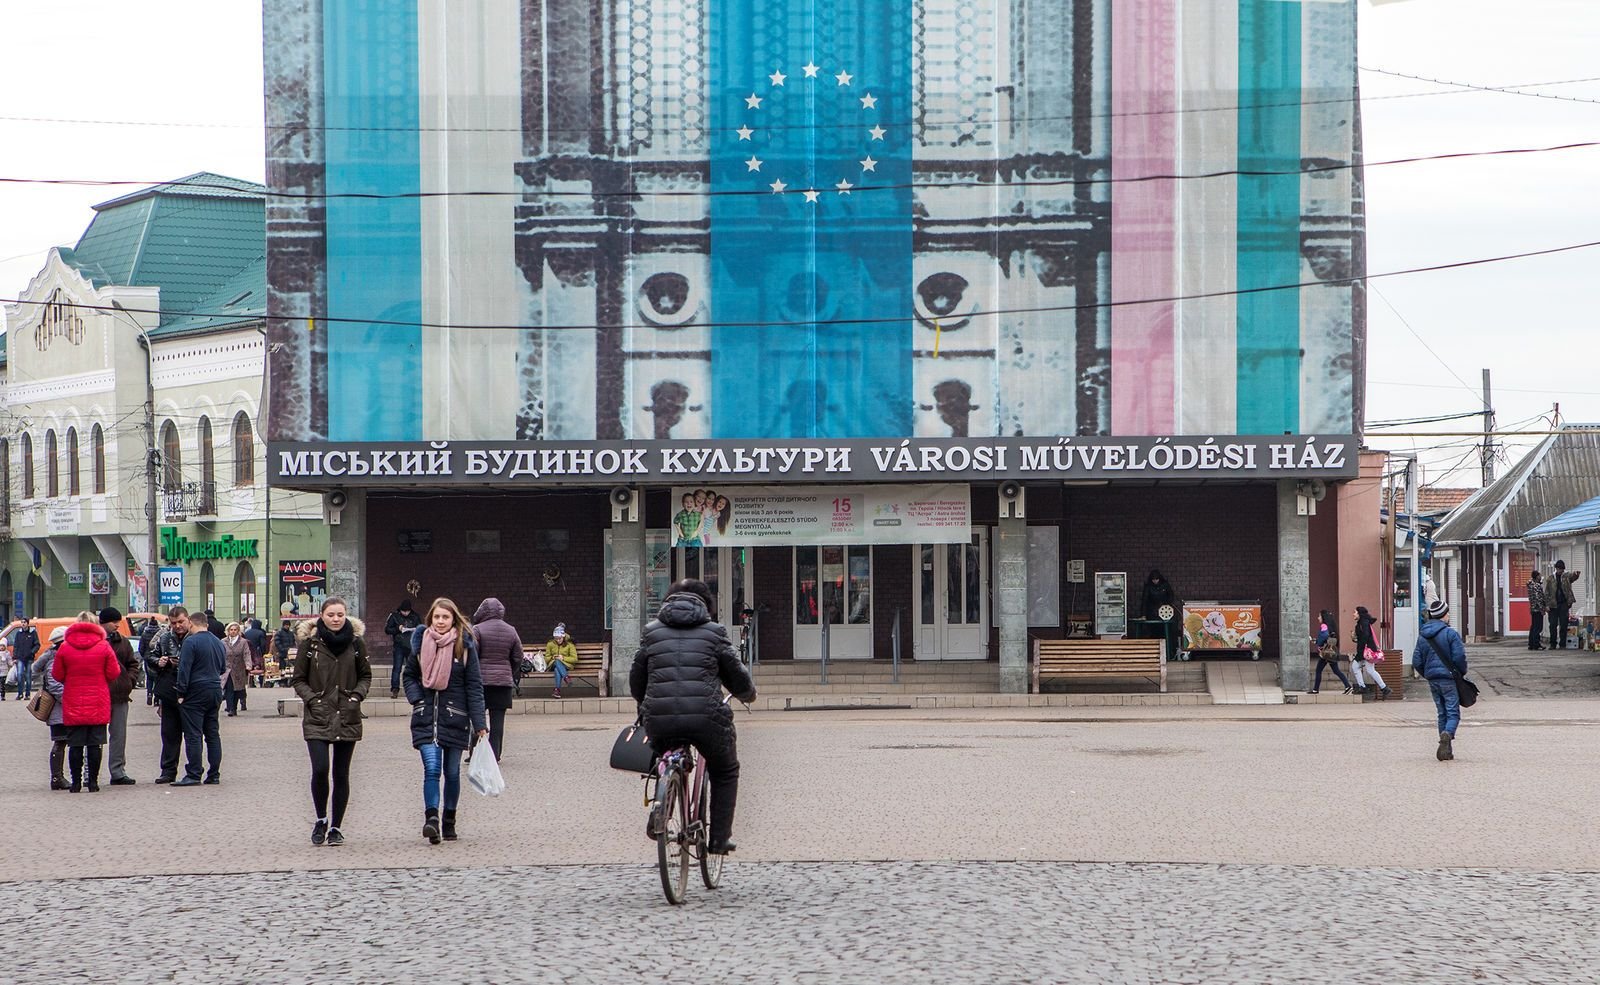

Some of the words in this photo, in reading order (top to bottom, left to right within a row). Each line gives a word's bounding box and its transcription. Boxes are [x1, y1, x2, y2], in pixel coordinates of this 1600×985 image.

[279, 441, 452, 476] МІСЬКИЙ
[465, 449, 648, 478] БУДИНОК
[660, 447, 852, 473] КУЛЬТУРИ
[871, 439, 1007, 472] VÁROSI
[1019, 437, 1257, 471] MŰVELŐDÉSI
[1269, 436, 1345, 469] HÁZ
[832, 497, 852, 513] 15
[174, 534, 259, 564] ПриватБанк
[284, 562, 323, 573] AVON
[162, 577, 180, 587] WC
